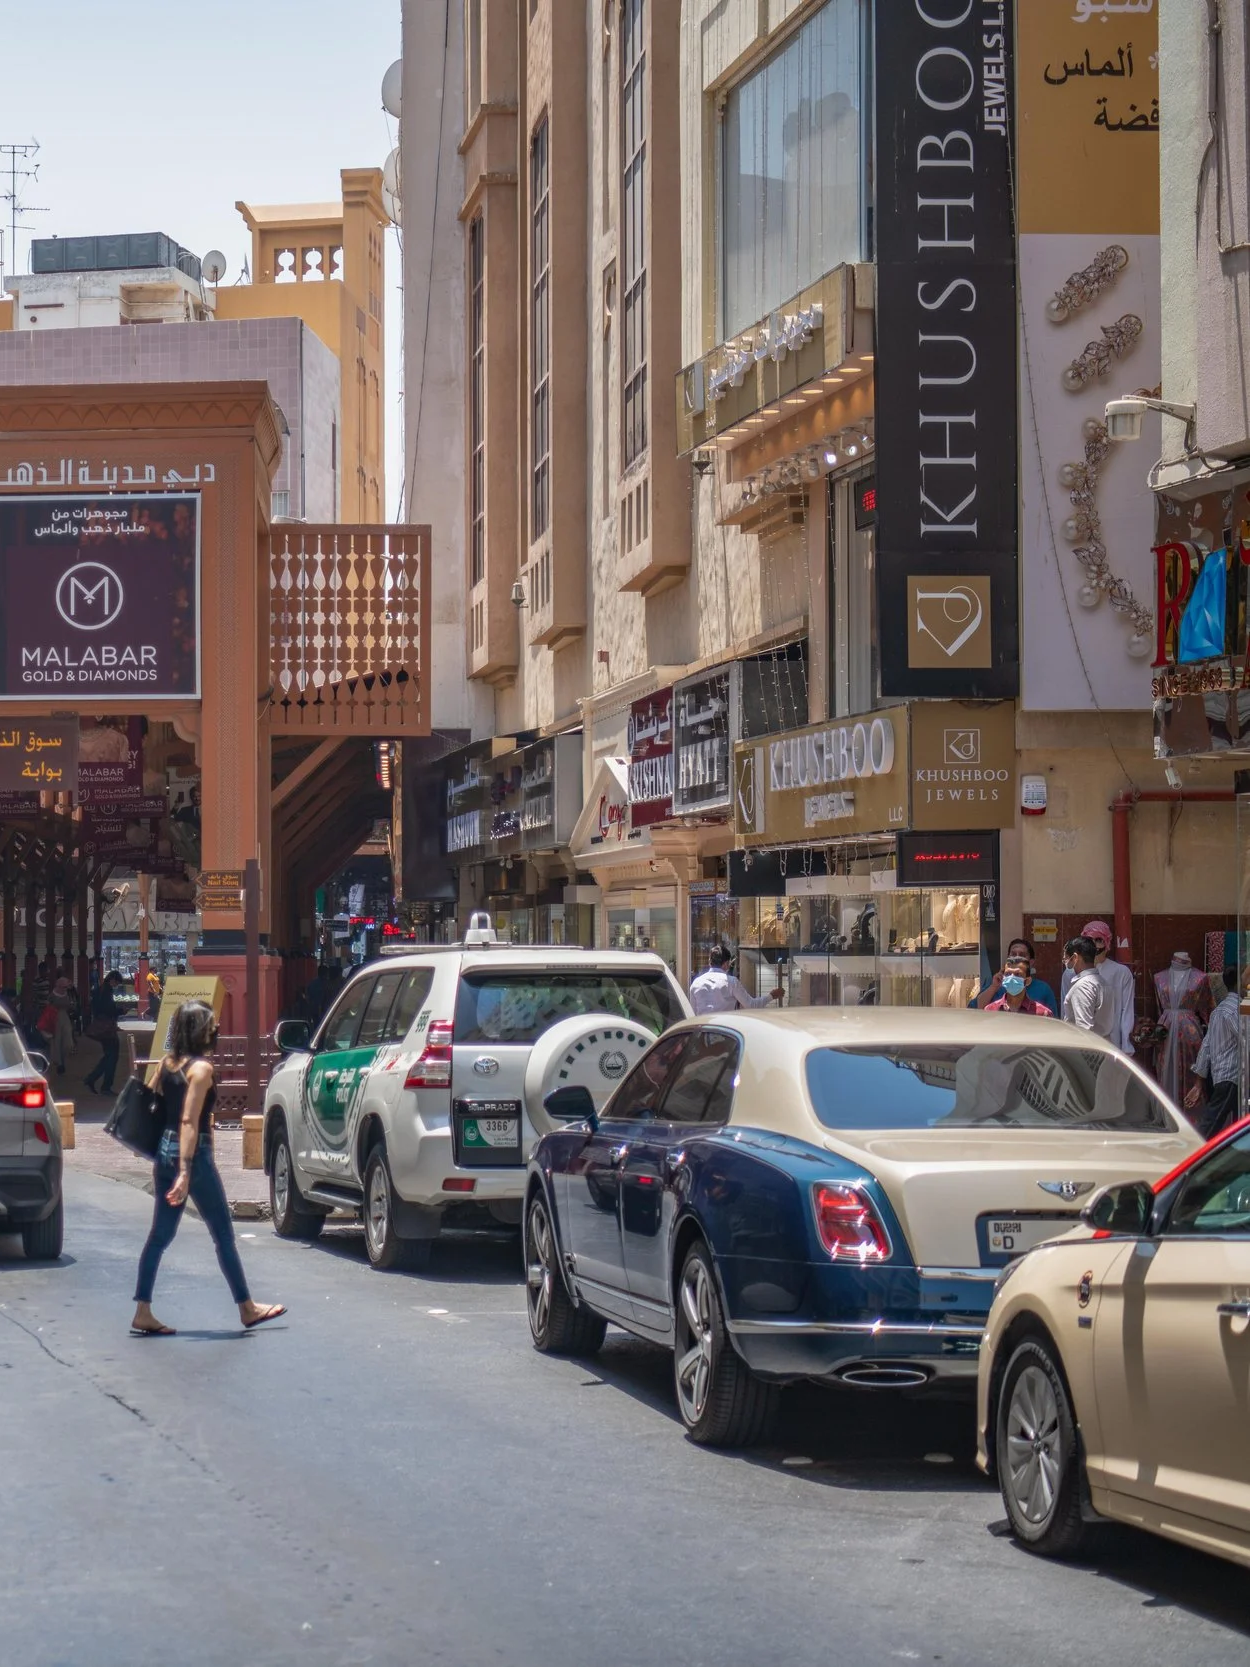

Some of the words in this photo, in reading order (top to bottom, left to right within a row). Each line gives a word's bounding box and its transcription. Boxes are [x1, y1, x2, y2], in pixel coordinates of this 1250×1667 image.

[1043, 42, 1134, 85] ألماس
[982, 33, 1006, 137] JEWELS
[78, 459, 156, 490] مدينة
[162, 463, 216, 488] دبي
[51, 508, 70, 521] من
[72, 506, 128, 520] مجوهرات
[34, 520, 79, 537] وألماس
[81, 522, 112, 535] ذهب
[114, 521, 146, 536] ملبار
[21, 645, 158, 667] MALABAR
[22, 670, 63, 682] GOLD
[66, 671, 76, 682] &
[78, 669, 158, 682] DIAMONDS
[1151, 673, 1188, 698] SINCE
[24, 732, 63, 753] سوق
[770, 718, 895, 792] KHUSHBOO
[678, 738, 720, 789] HYATT
[21, 761, 63, 783] بوابة
[627, 754, 673, 804] KRISHNA
[915, 769, 1009, 781] KHUSHBOO
[926, 789, 999, 804] JEWELS
[888, 806, 903, 822] LLC
[484, 1103, 516, 1112] PRADO
[486, 1121, 508, 1132] 3366
[993, 1222, 1022, 1234] DUBAI
[1003, 1236, 1015, 1249] D
